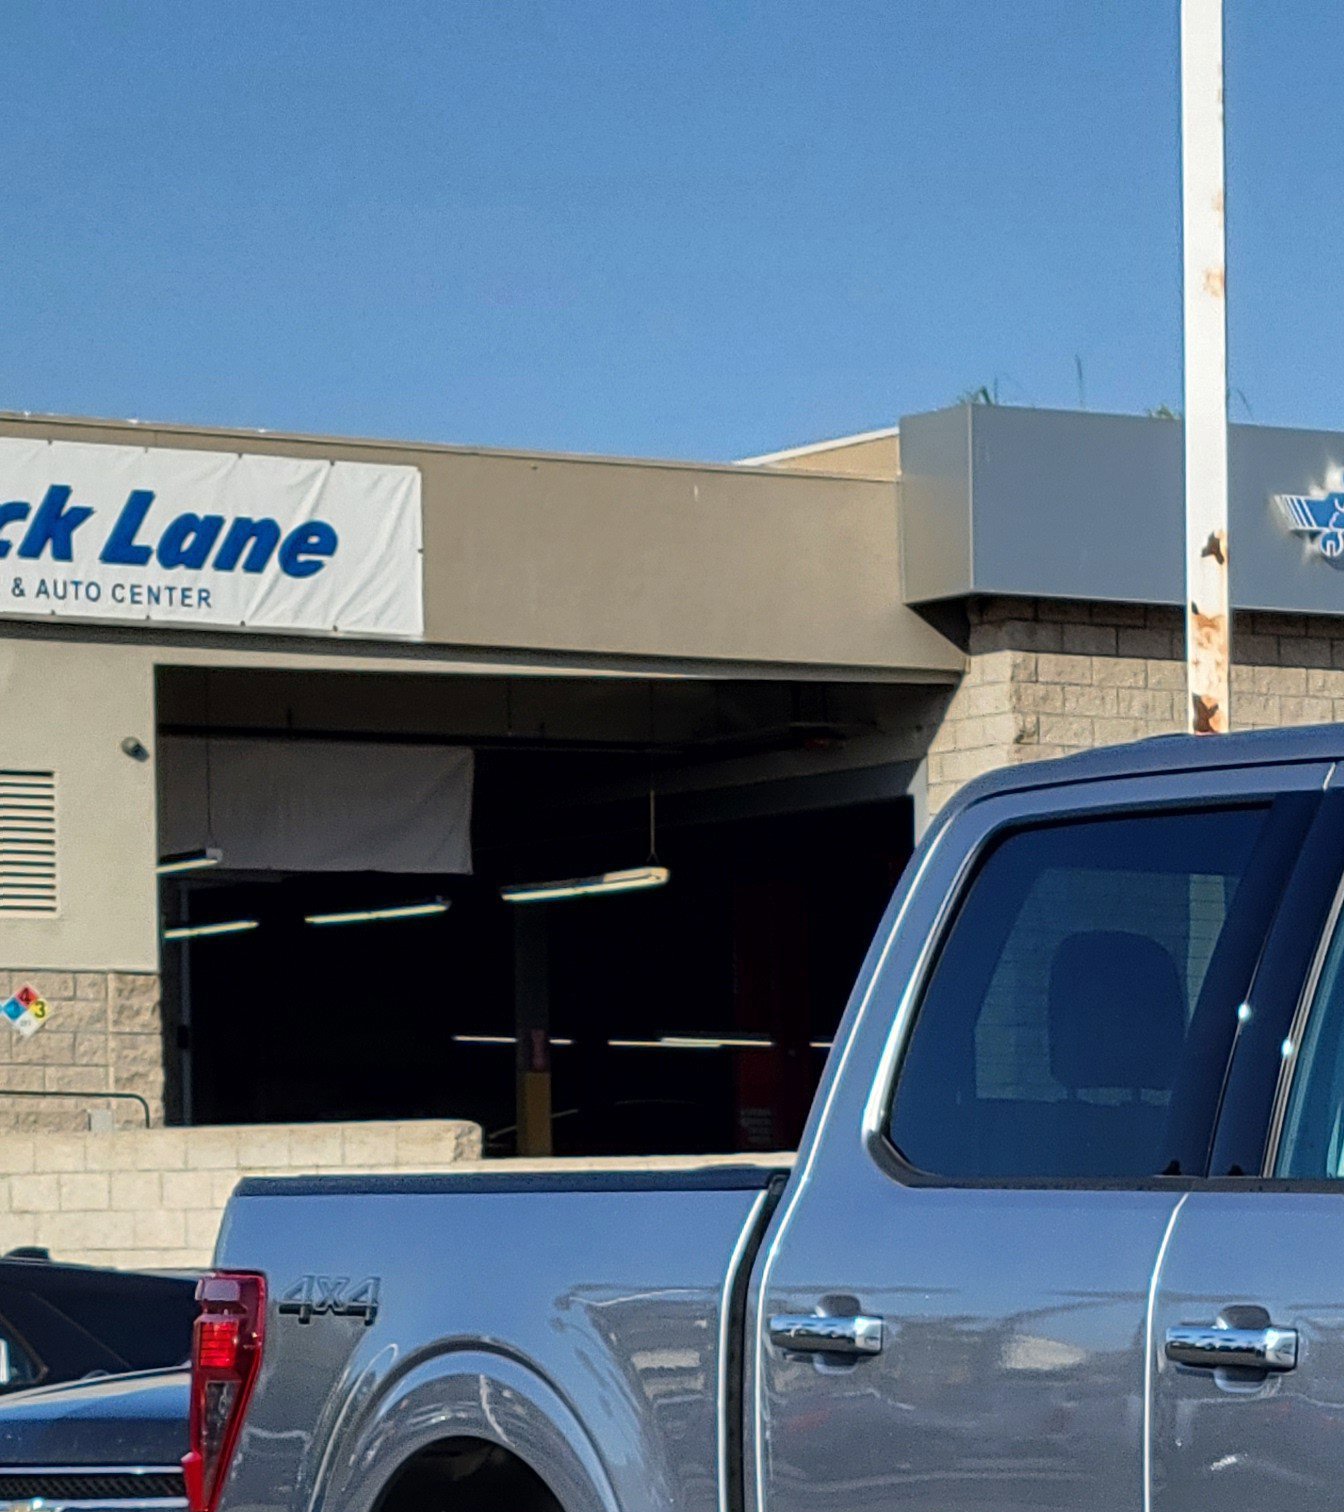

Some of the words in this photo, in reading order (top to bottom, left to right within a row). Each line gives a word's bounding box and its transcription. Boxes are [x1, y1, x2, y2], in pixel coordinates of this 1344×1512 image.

[99, 489, 338, 579] Lane
[11, 577, 26, 598] &
[35, 579, 101, 602] AUTO
[111, 583, 212, 609] CENTER
